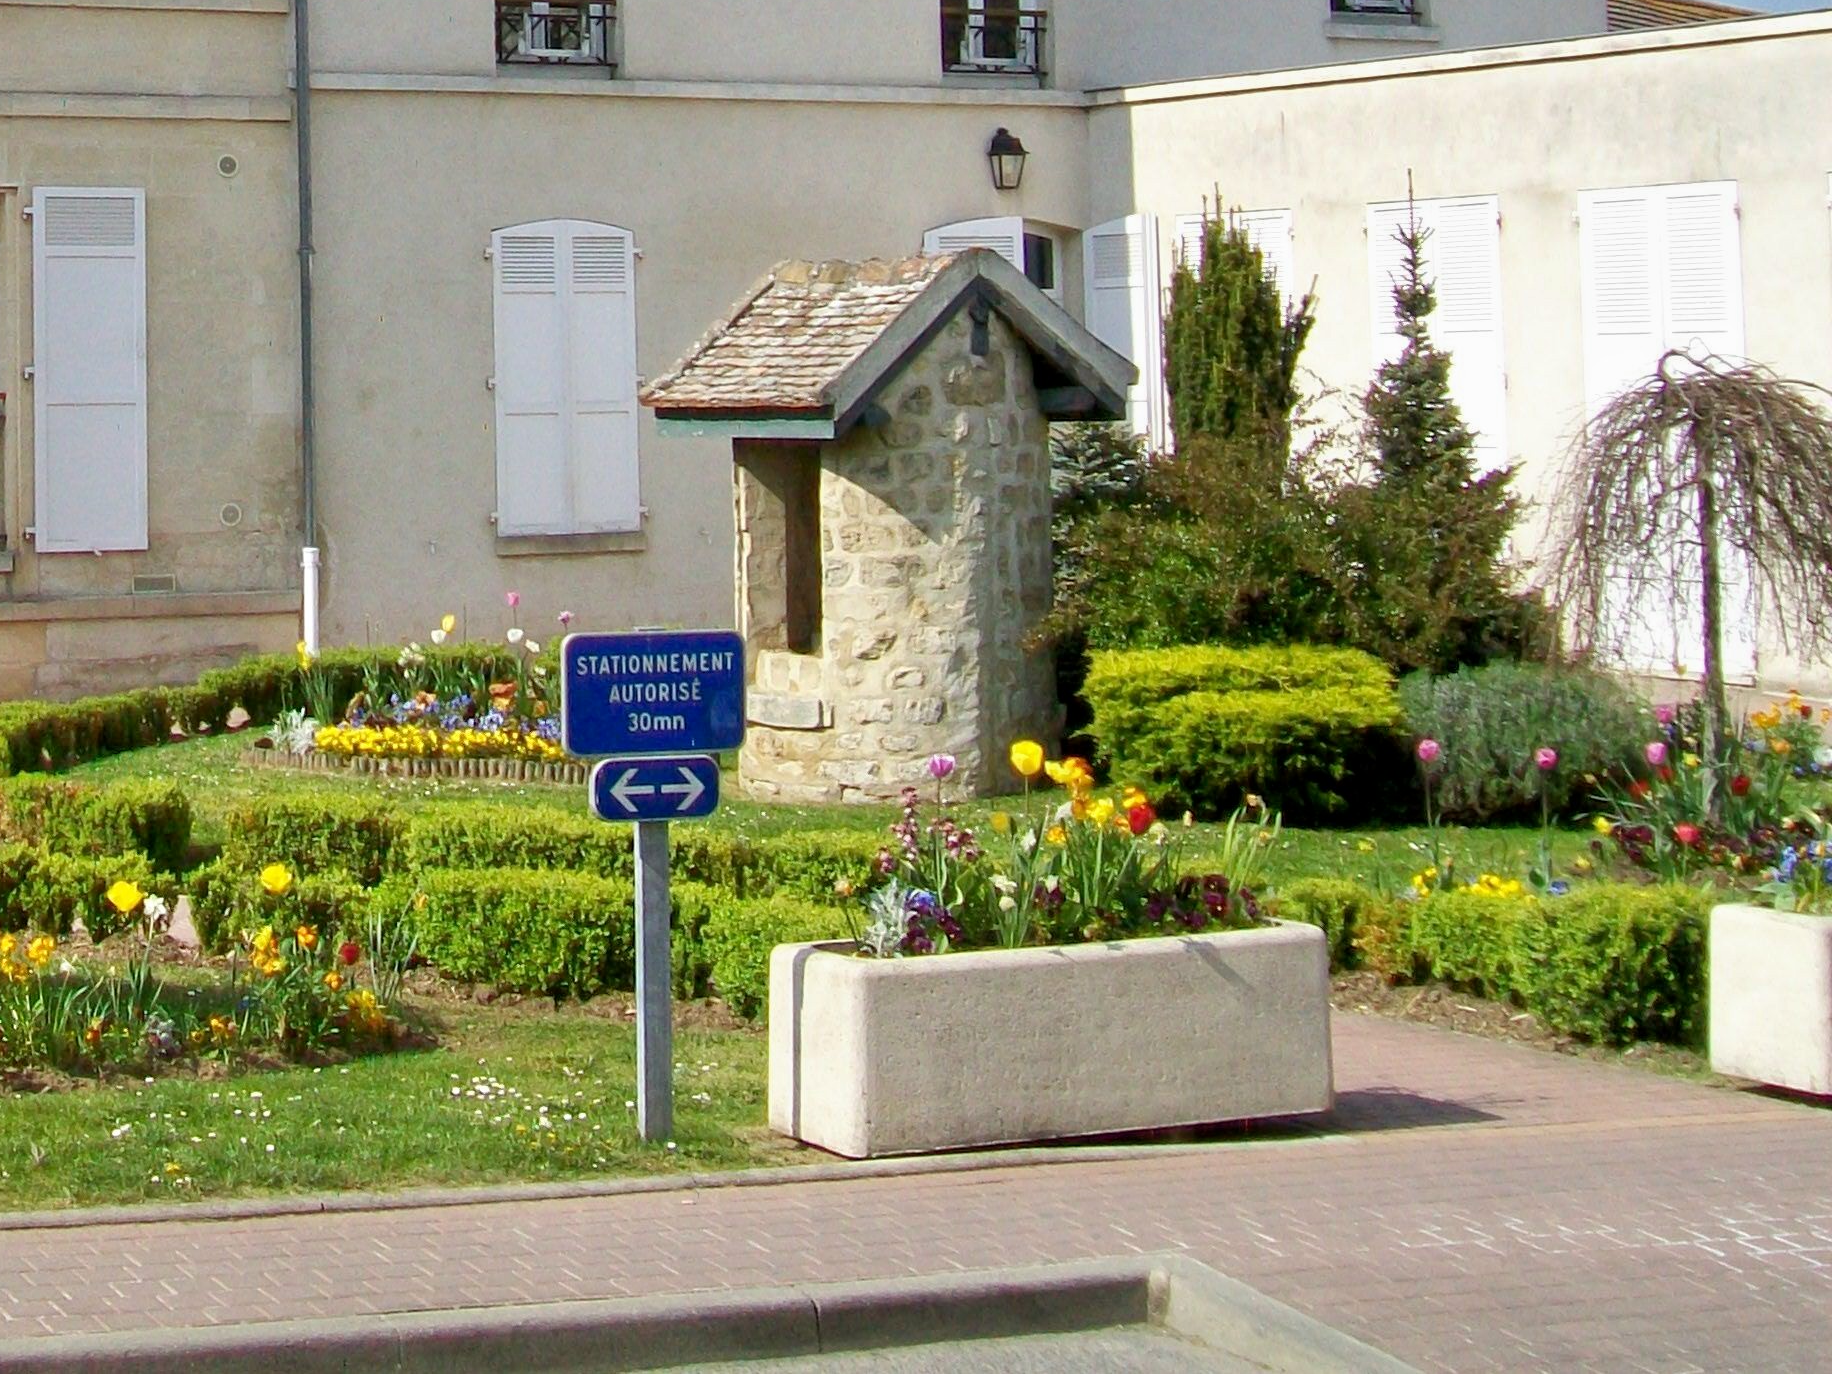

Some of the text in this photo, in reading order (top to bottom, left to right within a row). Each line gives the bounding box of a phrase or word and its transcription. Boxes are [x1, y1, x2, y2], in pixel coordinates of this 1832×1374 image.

[576, 651, 735, 676] STATIONNEMENT
[609, 677, 702, 704] AUTORISÉ
[628, 712, 686, 732] 30mn
